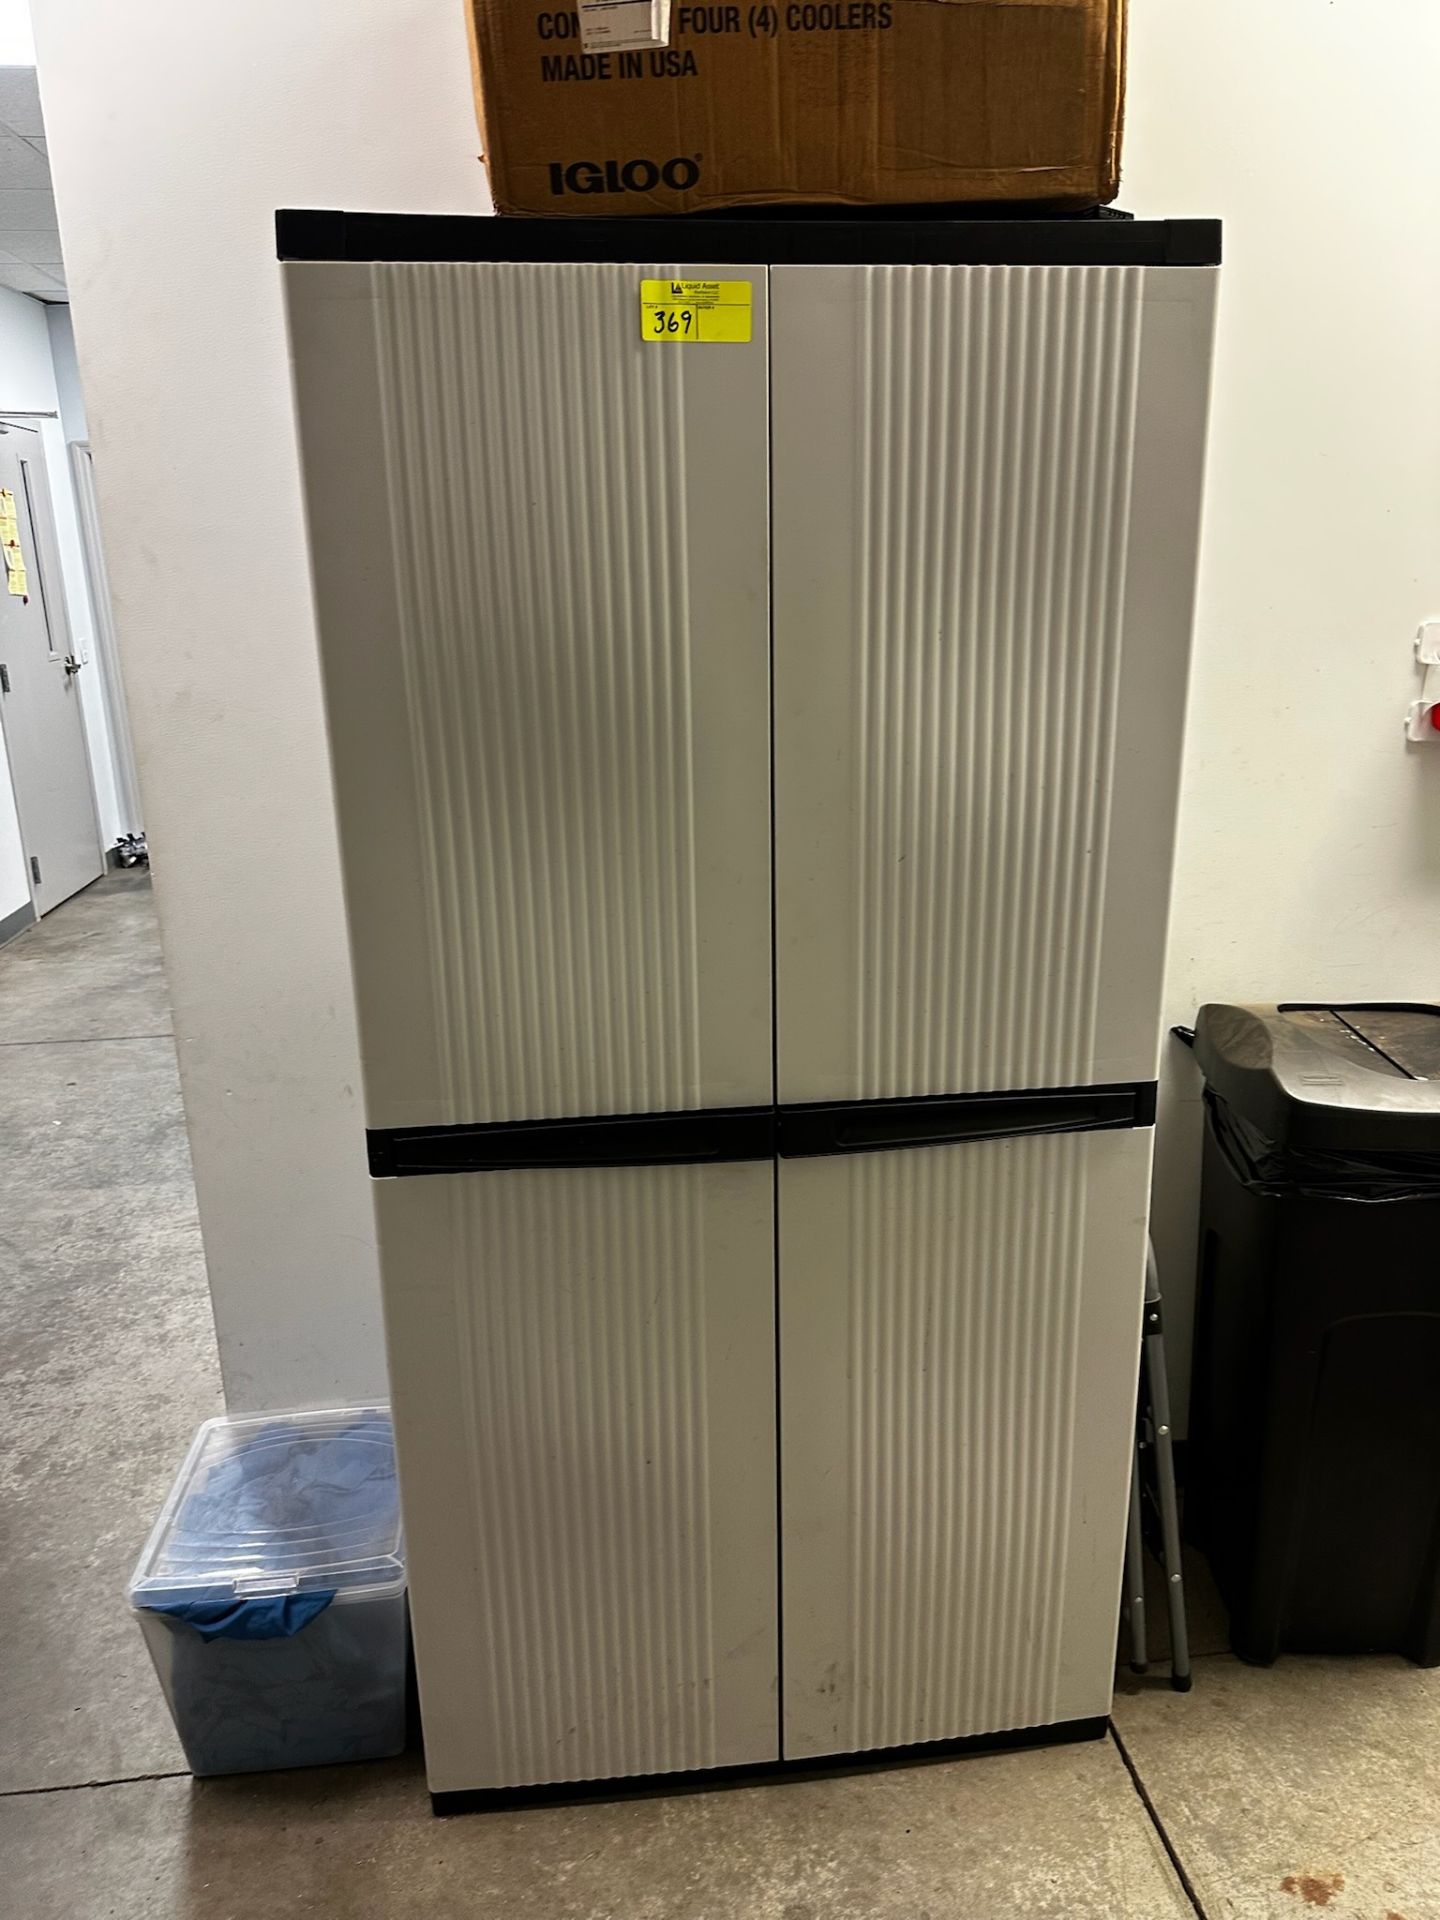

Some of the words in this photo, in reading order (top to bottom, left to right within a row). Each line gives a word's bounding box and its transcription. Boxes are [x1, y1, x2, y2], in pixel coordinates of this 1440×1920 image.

[678, 6, 741, 34] FOUR
[748, 5, 779, 38] (4)
[786, 2, 893, 31] COOLERS
[540, 53, 612, 82] MADE
[618, 52, 643, 79] IN
[650, 50, 698, 78] USA
[549, 157, 699, 195] IGLOO
[654, 310, 692, 334] 369
